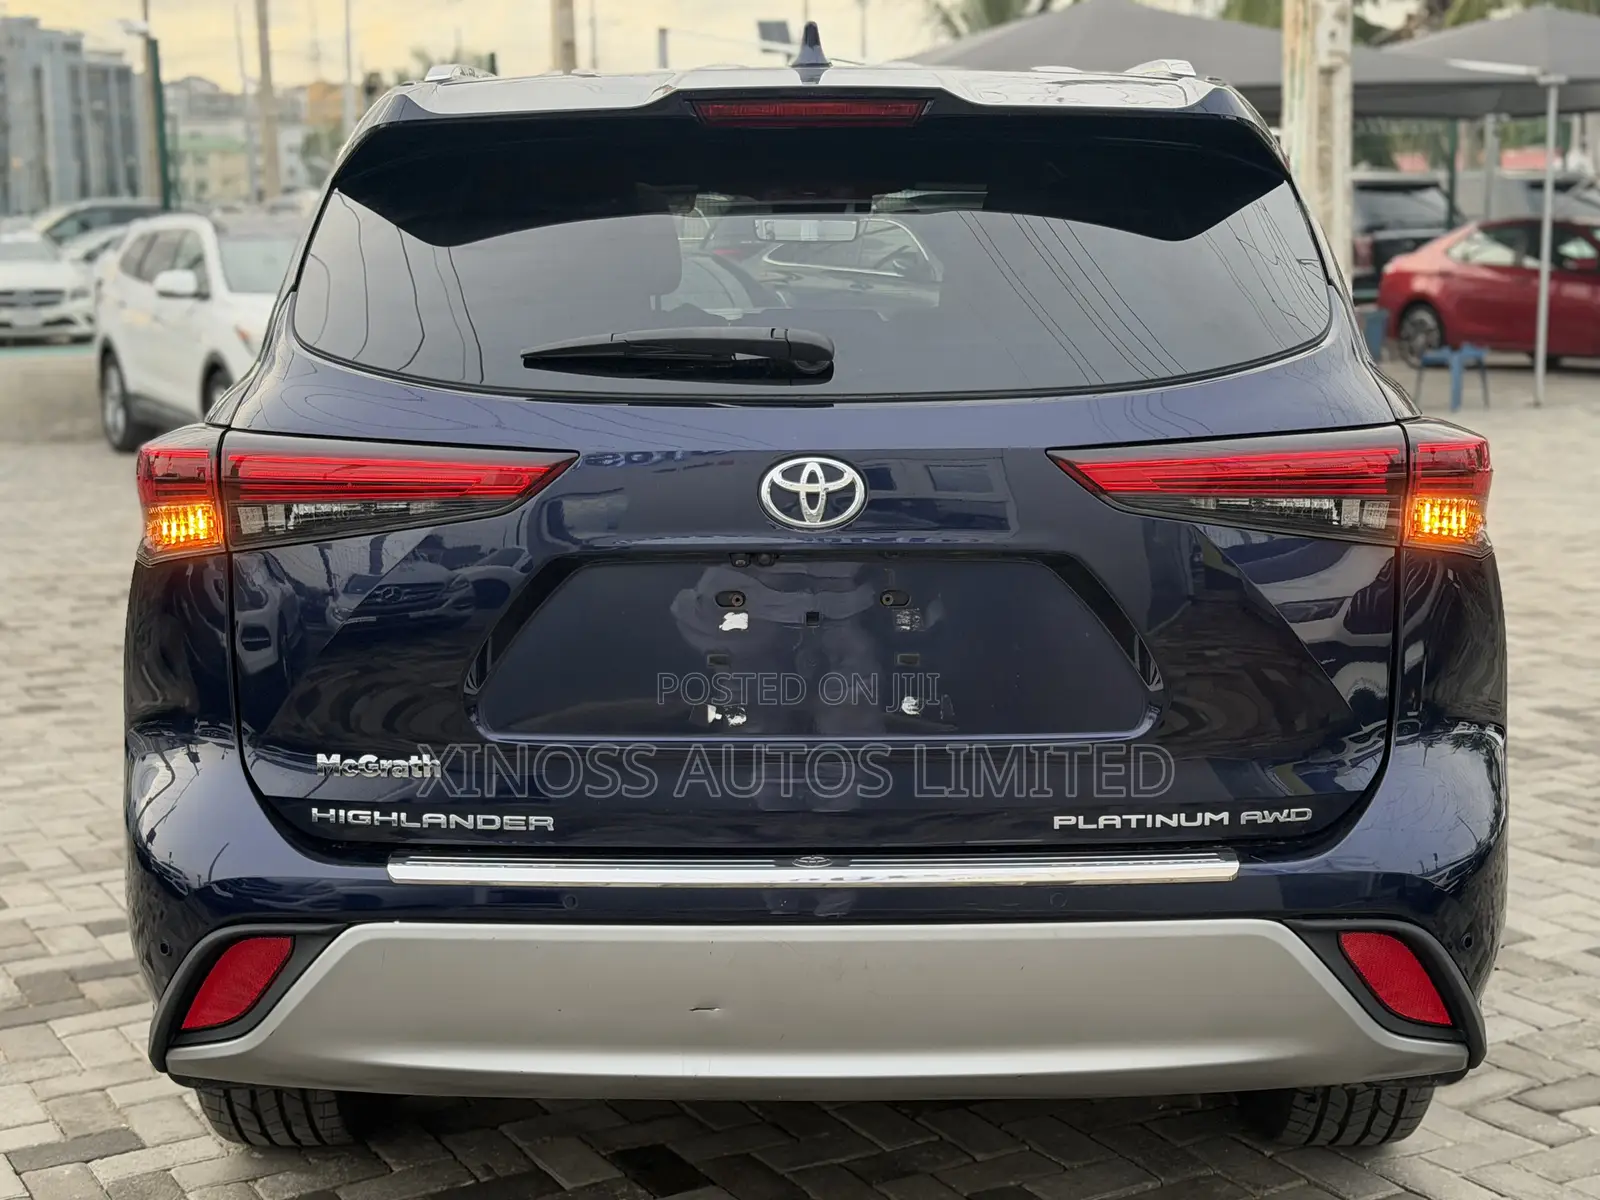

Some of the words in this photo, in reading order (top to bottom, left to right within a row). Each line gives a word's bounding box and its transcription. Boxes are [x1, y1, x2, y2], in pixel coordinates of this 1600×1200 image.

[316, 753, 442, 779] McGrath
[311, 807, 555, 832] HIGHLANDER
[1053, 811, 1230, 830] PLATINUM
[1240, 807, 1313, 825] AWD
